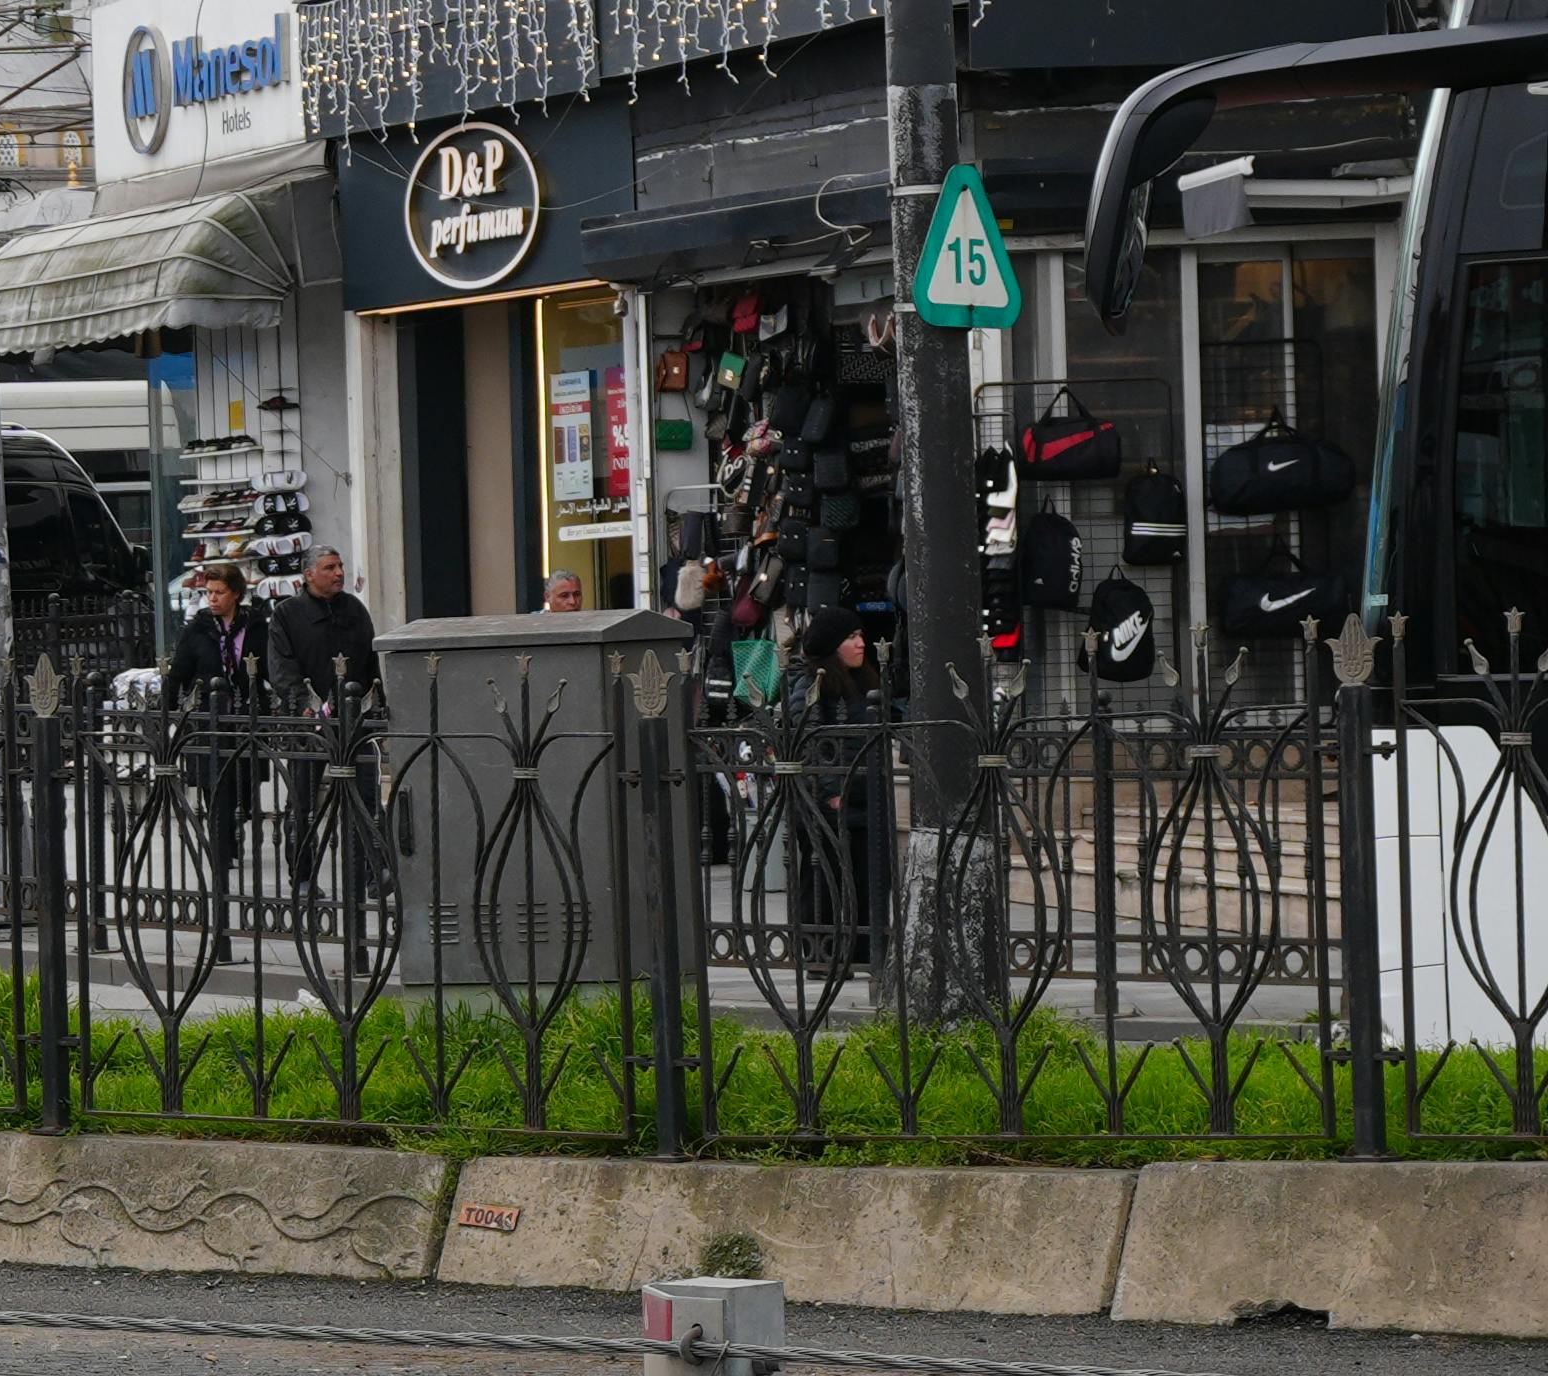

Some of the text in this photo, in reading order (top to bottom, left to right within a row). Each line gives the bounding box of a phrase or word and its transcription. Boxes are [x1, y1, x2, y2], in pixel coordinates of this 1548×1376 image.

[172, 13, 290, 107] Manesol
[222, 107, 251, 135] Hotels
[438, 139, 504, 200] D&P
[429, 202, 524, 259] perfumum
[948, 237, 987, 286] 15
[1113, 610, 1143, 648] NIKE
